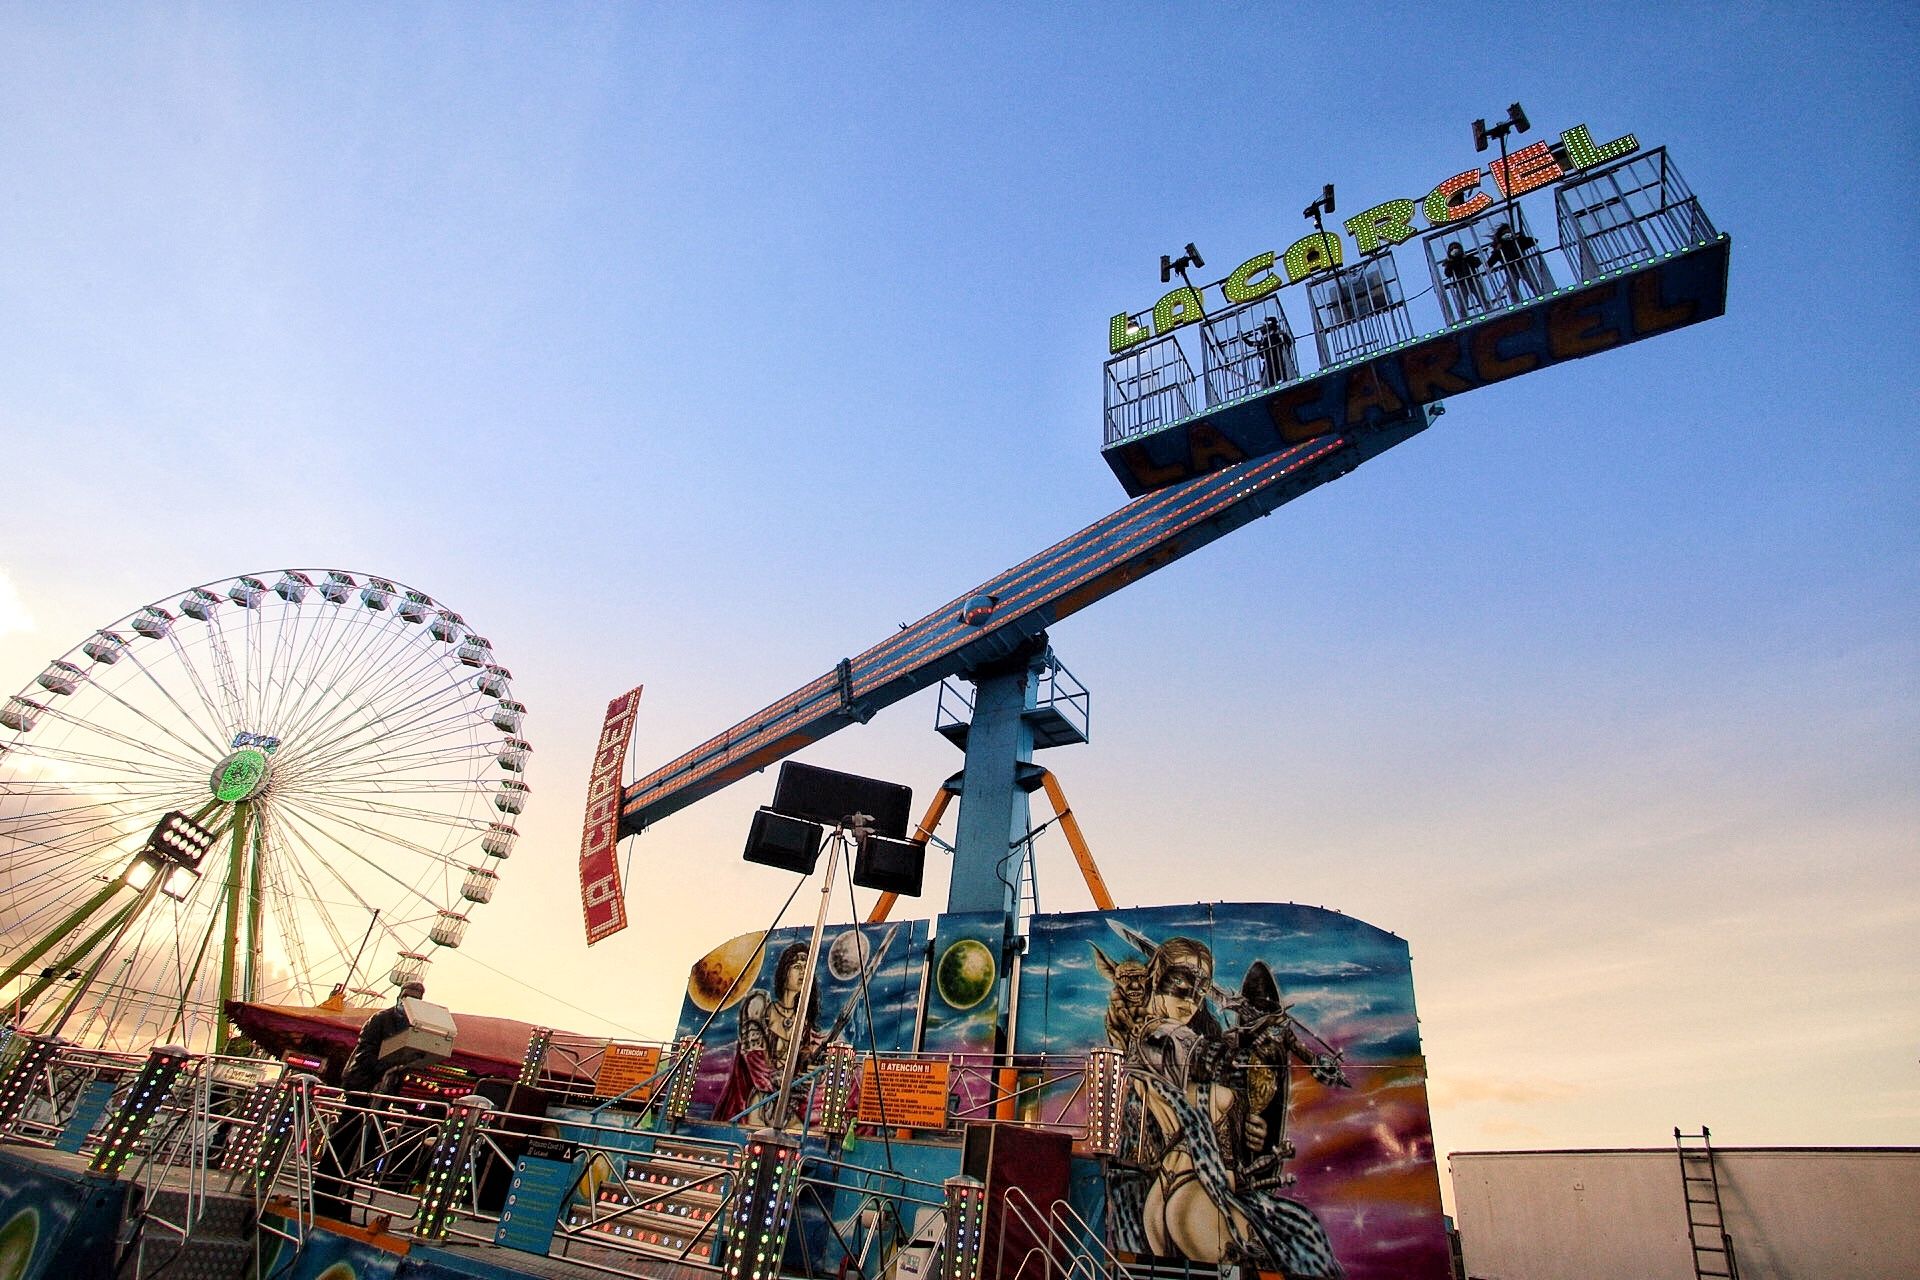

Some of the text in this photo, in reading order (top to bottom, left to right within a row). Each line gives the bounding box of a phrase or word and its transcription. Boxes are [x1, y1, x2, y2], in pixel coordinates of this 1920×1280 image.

[1110, 123, 1640, 354] LA CARCEL
[1120, 267, 1697, 488] LA CARCEL
[583, 690, 636, 936] LA CARCEL
[886, 1063, 924, 1073] ATENCIÓN
